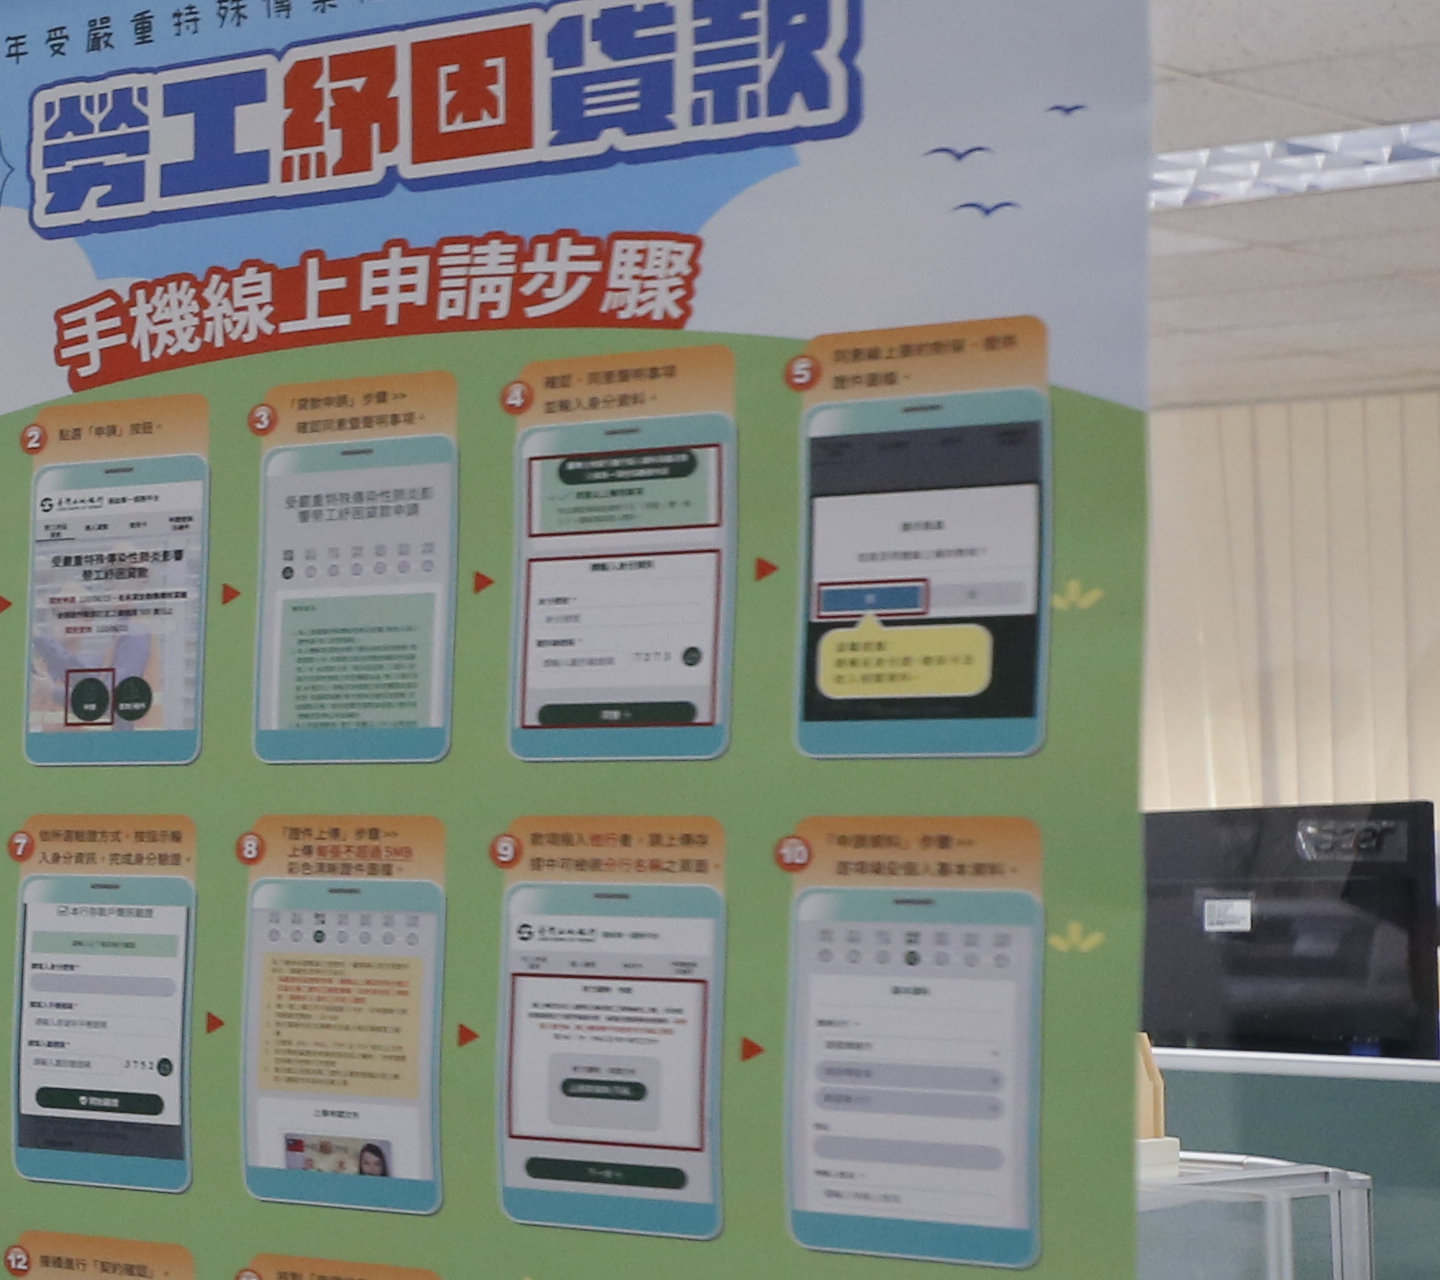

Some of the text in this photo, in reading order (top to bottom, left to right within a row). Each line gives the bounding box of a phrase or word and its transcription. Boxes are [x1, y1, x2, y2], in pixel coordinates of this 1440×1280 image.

[58, 236, 700, 379] 手機線上申請步驟
